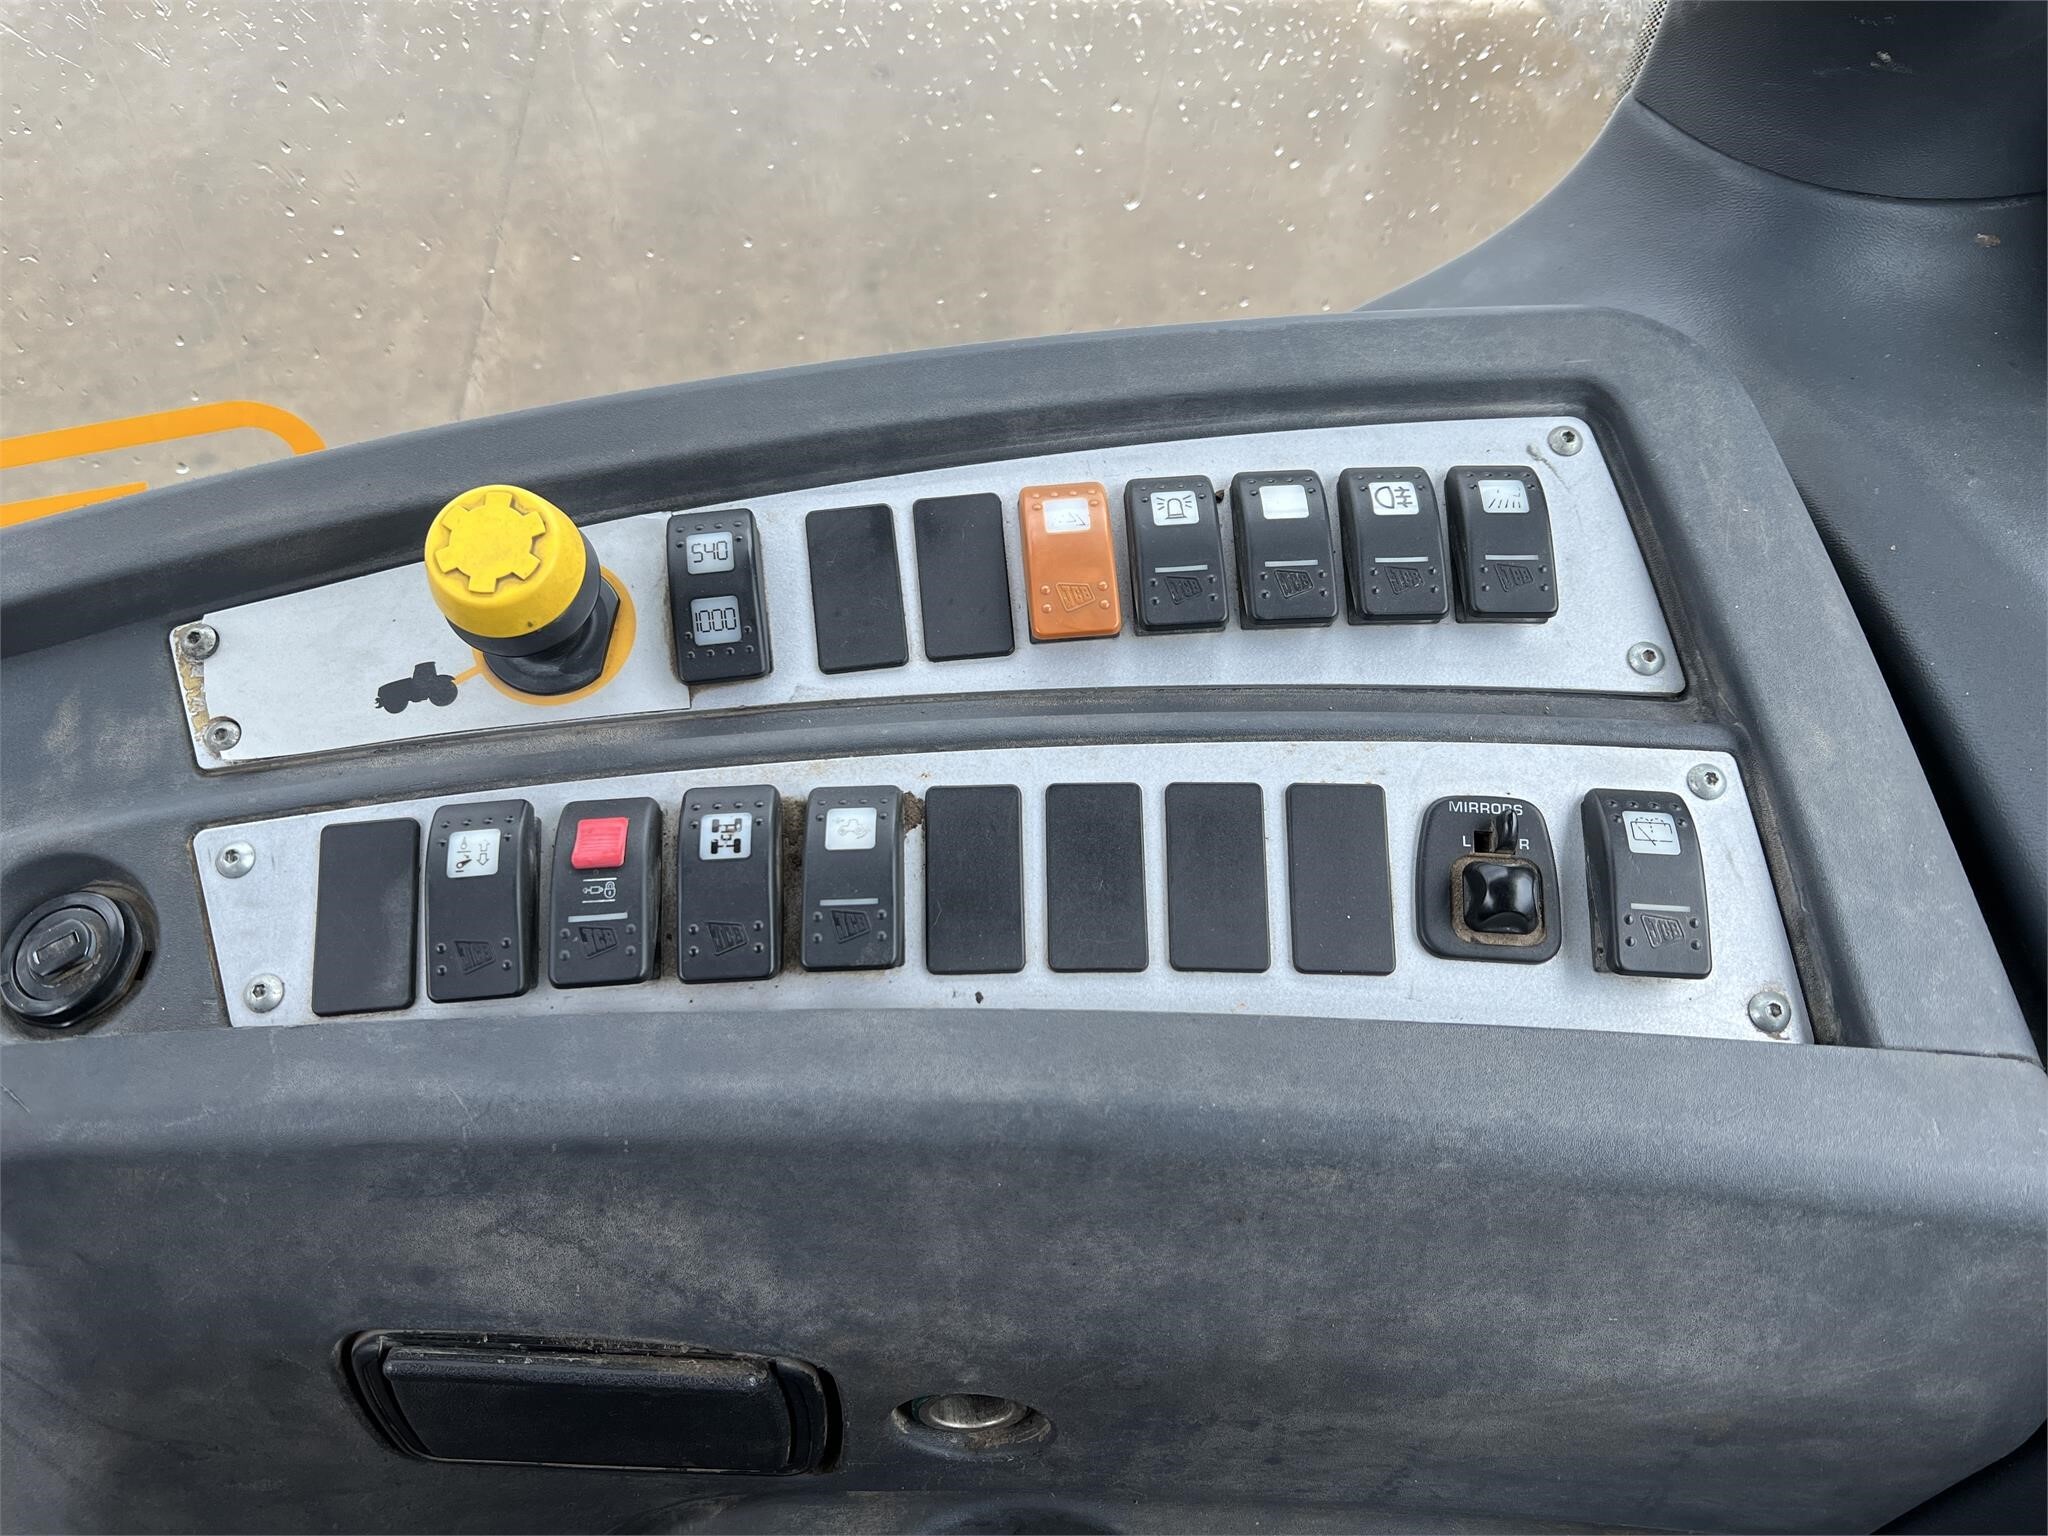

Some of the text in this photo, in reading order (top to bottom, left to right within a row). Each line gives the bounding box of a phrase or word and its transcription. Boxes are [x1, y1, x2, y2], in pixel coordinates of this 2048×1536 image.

[691, 540, 729, 563] 540
[695, 607, 737, 633] 1000
[1462, 835, 1530, 850] L R
